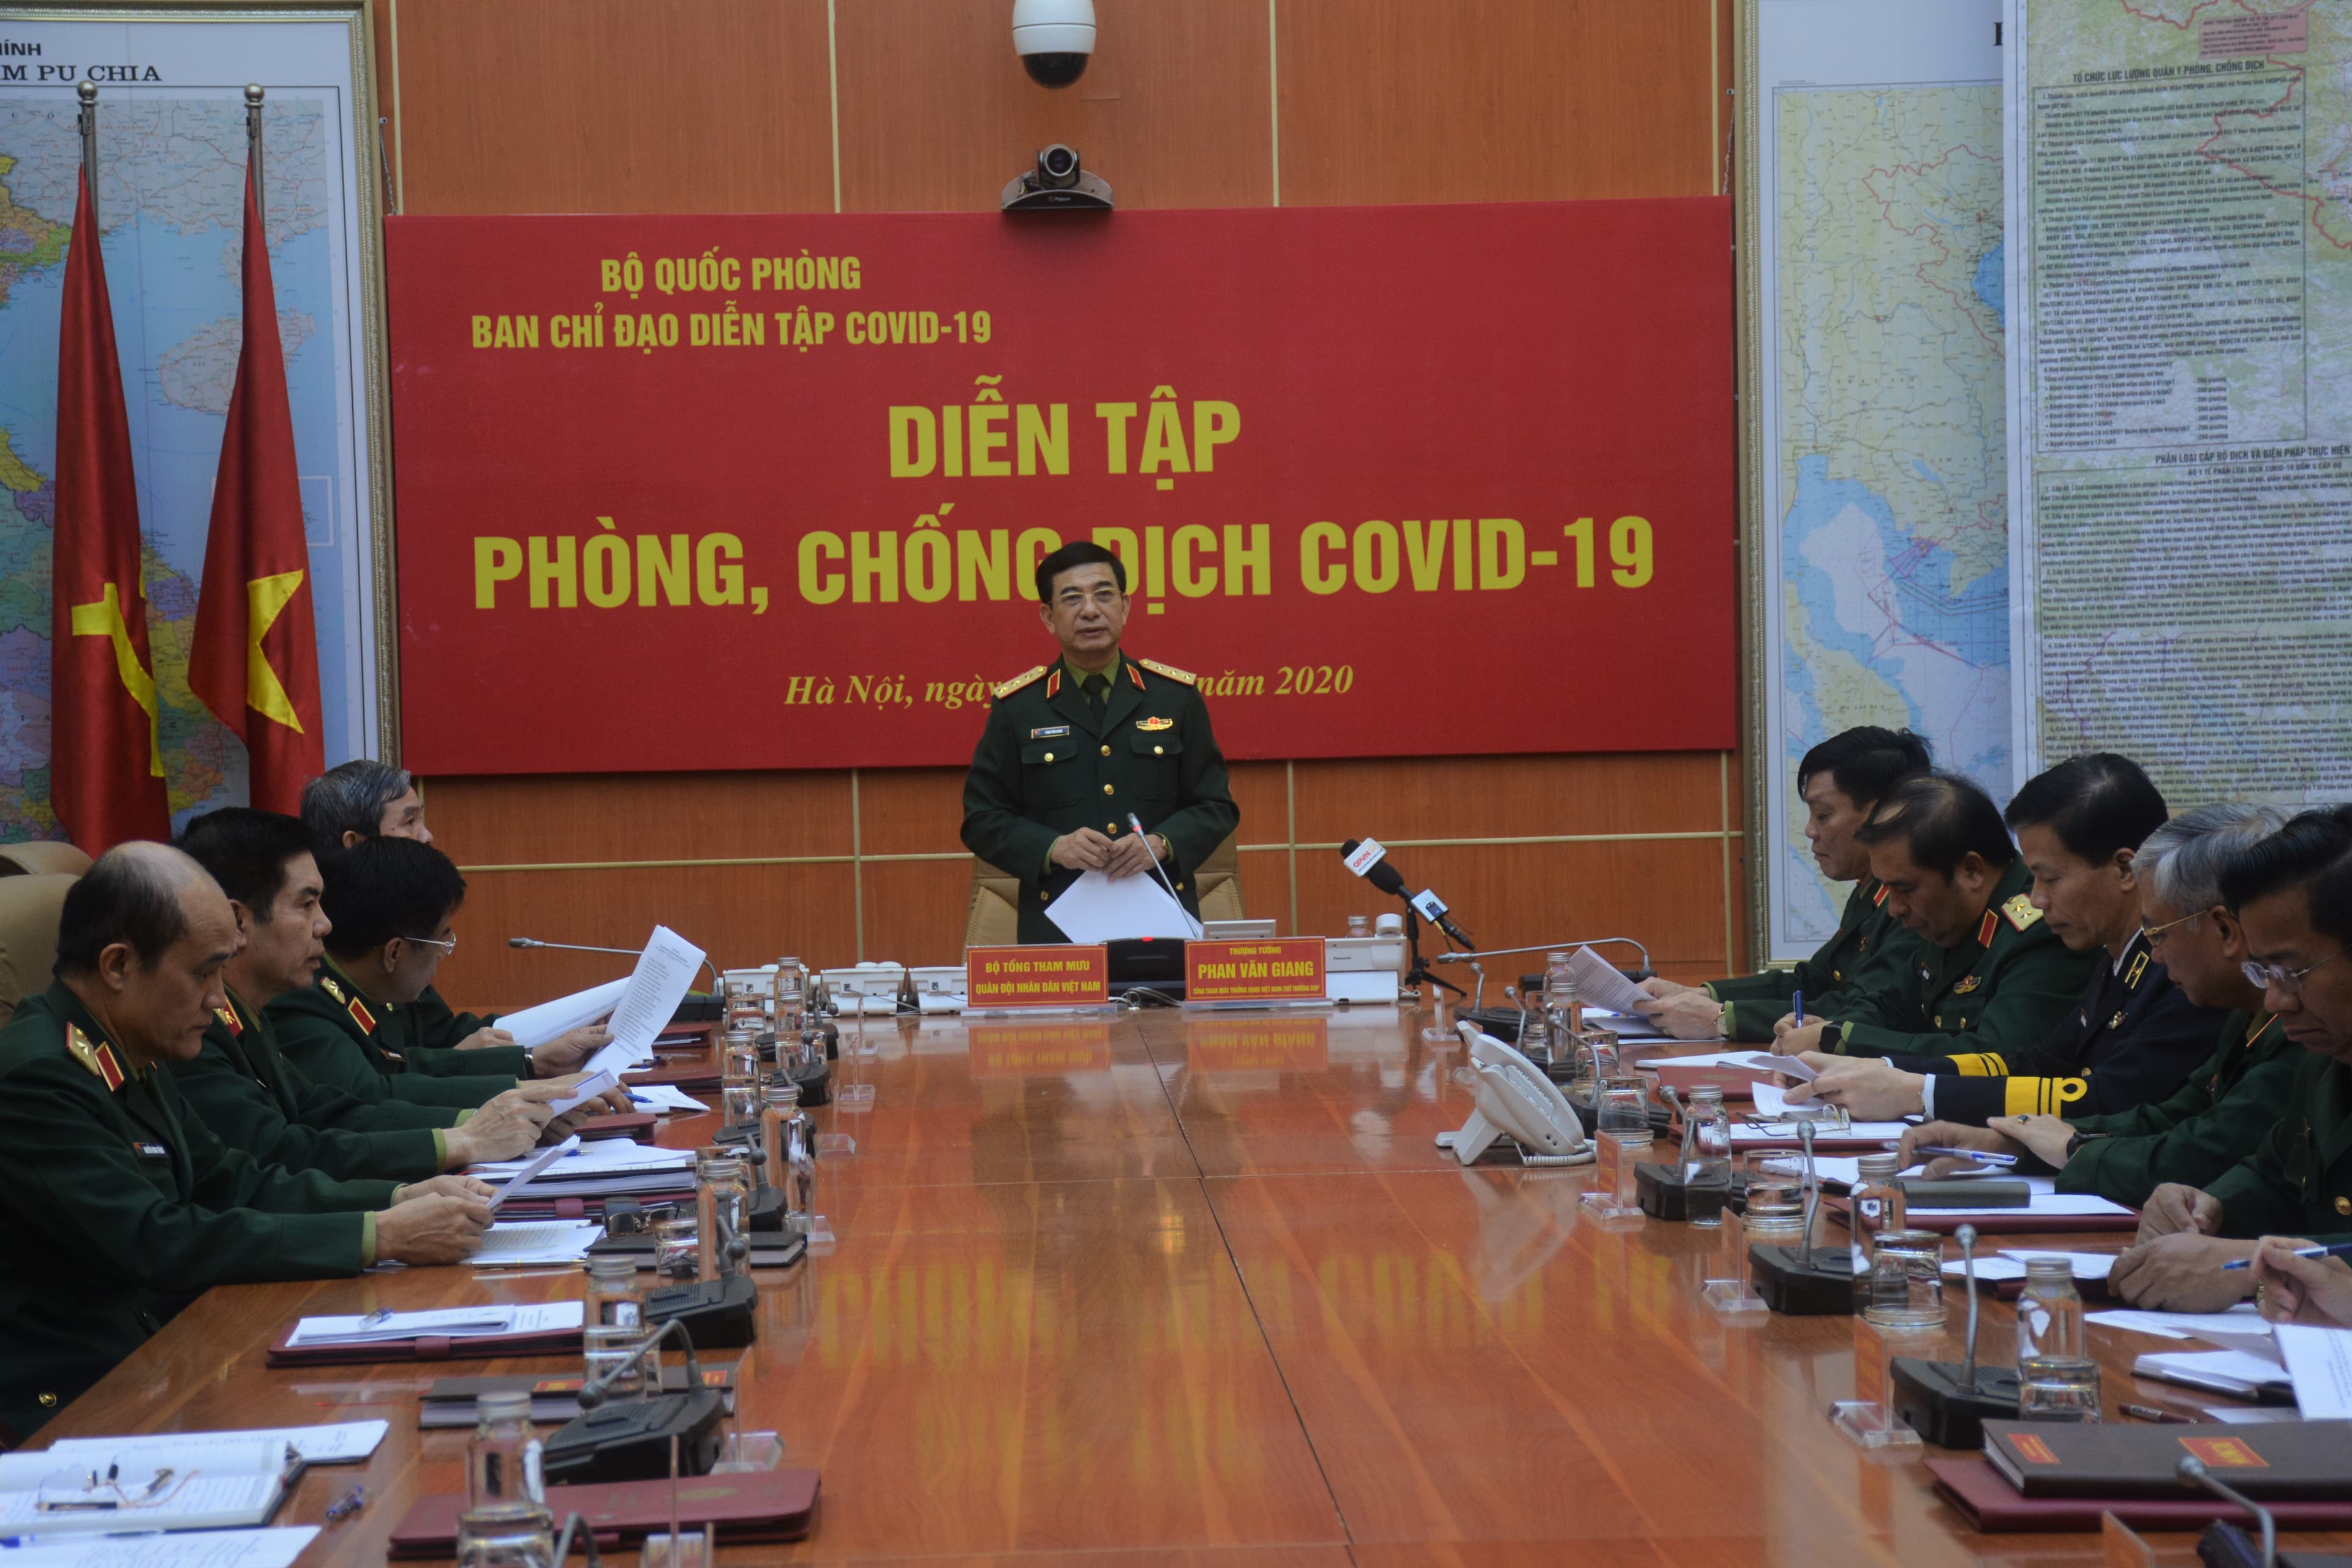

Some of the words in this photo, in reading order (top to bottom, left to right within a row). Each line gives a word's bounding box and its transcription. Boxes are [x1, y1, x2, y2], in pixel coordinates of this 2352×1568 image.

[37, 65, 77, 81] PU
[87, 65, 162, 81] CHIA
[601, 252, 644, 299] BỘ
[655, 246, 741, 294] QUỐC
[752, 249, 861, 290] PHÒNG
[472, 315, 539, 349] BAN
[551, 302, 604, 348] CHỈ
[614, 313, 679, 353] ĐẠO
[690, 300, 765, 346] DIỄN
[775, 304, 835, 353] TẬP
[846, 310, 991, 344] COVID-19
[889, 374, 1069, 478] DIỄN
[1095, 385, 1242, 491] TẬP
[475, 516, 769, 615] PHÒNG,
[1300, 516, 1654, 595] COVID-19
[784, 676, 835, 704] Hà
[844, 674, 913, 710] Nội,
[1196, 669, 1265, 696] năm
[1274, 665, 1354, 695] 2020
[985, 960, 1000, 975] BỘ
[1003, 958, 1031, 973] TỔNG
[1033, 960, 1063, 972] THAM
[1066, 960, 1090, 971] MƯU
[1229, 947, 1257, 956] THƯỢNG
[1259, 945, 1282, 954] TƯỚNG
[1198, 963, 1236, 979] PHAN
[1239, 959, 1268, 978] VĂN
[1272, 961, 1314, 977] GIANG
[975, 981, 999, 995] QUÂN
[1001, 981, 1015, 995] ĐỘI
[1017, 981, 1041, 993] NHÂN
[1042, 980, 1060, 993] DÂN
[1061, 979, 1079, 994] VIỆT
[1081, 981, 1101, 992] NAM
